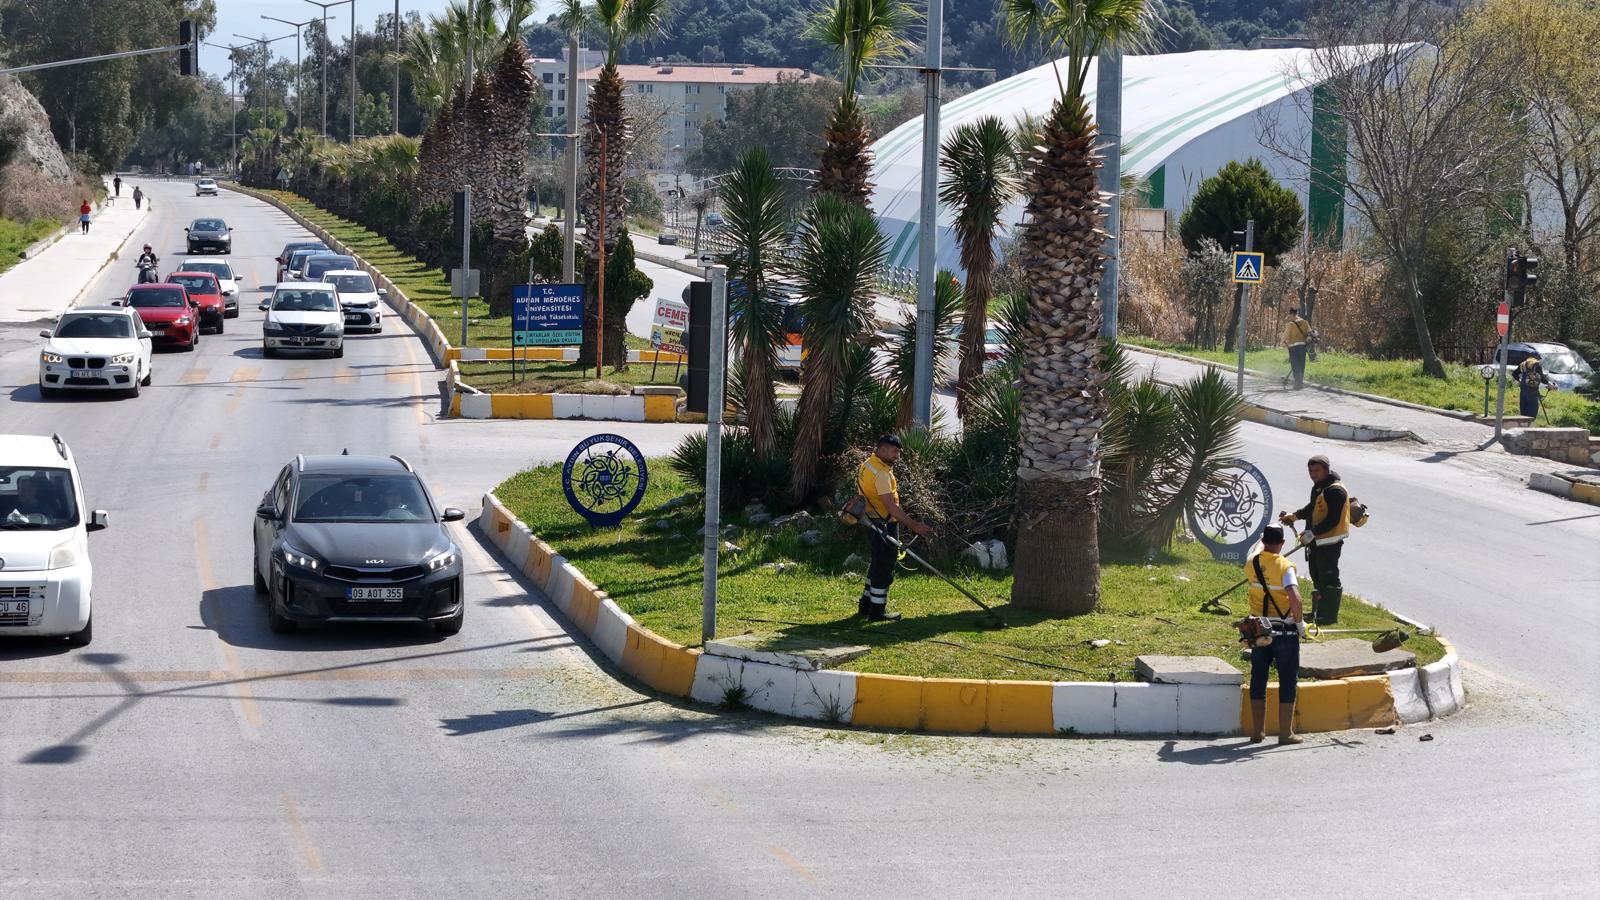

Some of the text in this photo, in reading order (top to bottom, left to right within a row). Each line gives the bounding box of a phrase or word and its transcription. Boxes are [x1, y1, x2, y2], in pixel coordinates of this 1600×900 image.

[657, 306, 690, 321] CEME
[353, 589, 401, 597] 09 AOT 355
[16, 602, 26, 611] 46
